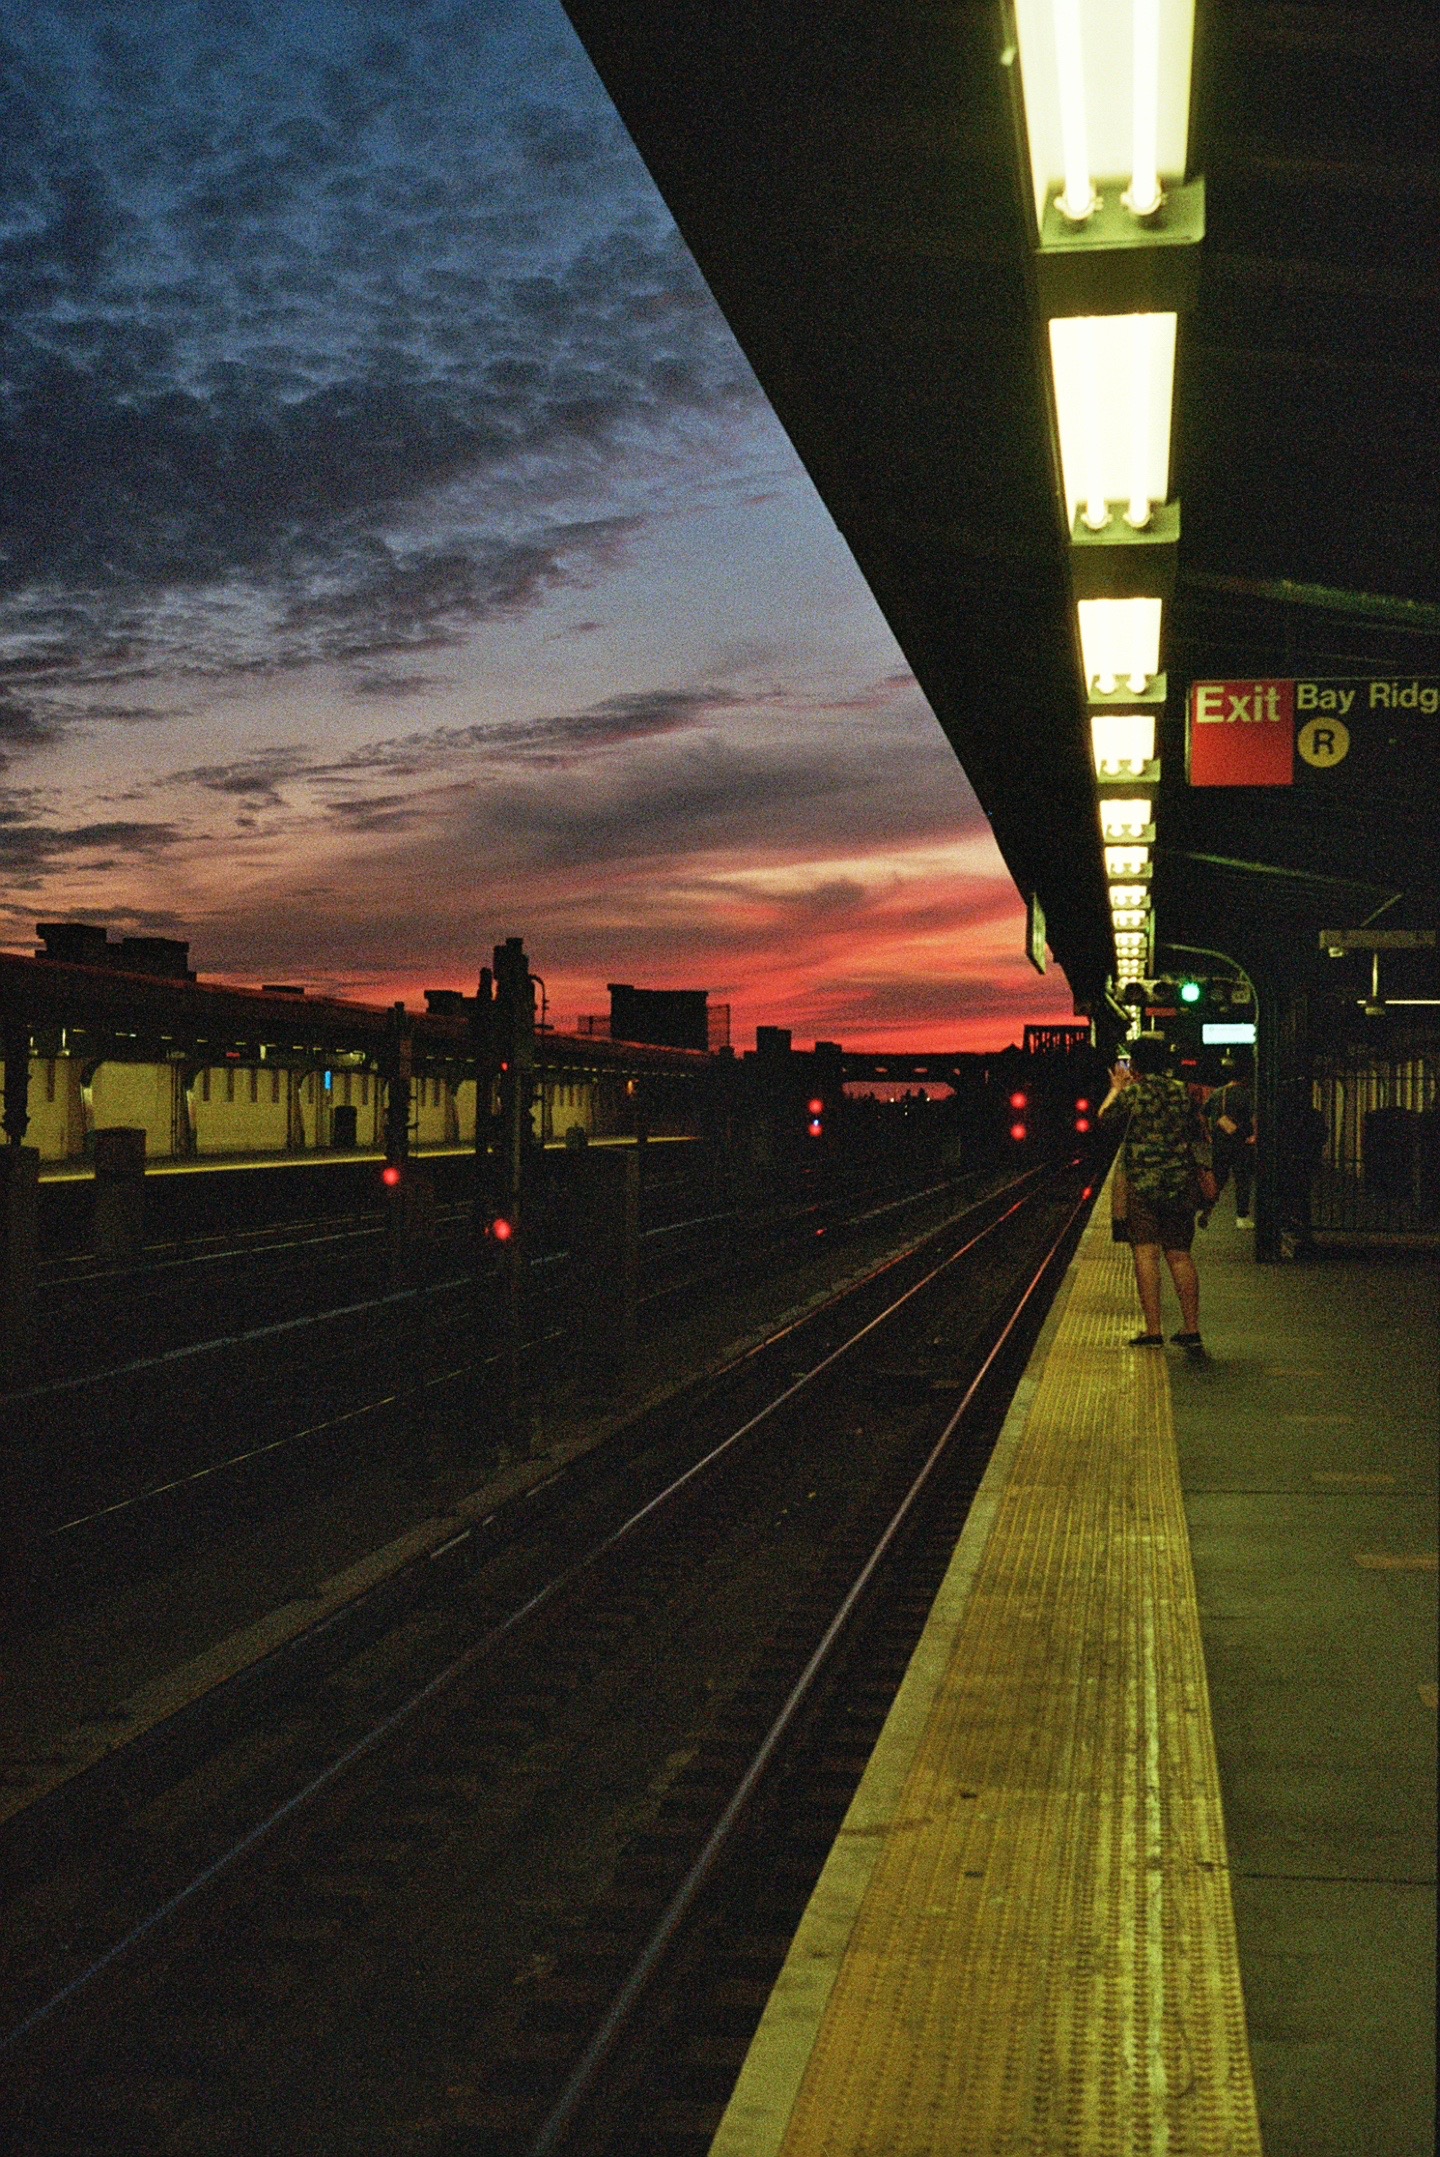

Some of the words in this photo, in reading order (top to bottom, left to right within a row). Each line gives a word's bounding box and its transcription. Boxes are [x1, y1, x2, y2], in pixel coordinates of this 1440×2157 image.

[1196, 685, 1281, 724] Exit
[1297, 683, 1356, 715] Bay
[1369, 682, 1439, 714] Ridg
[1312, 729, 1336, 755] R
